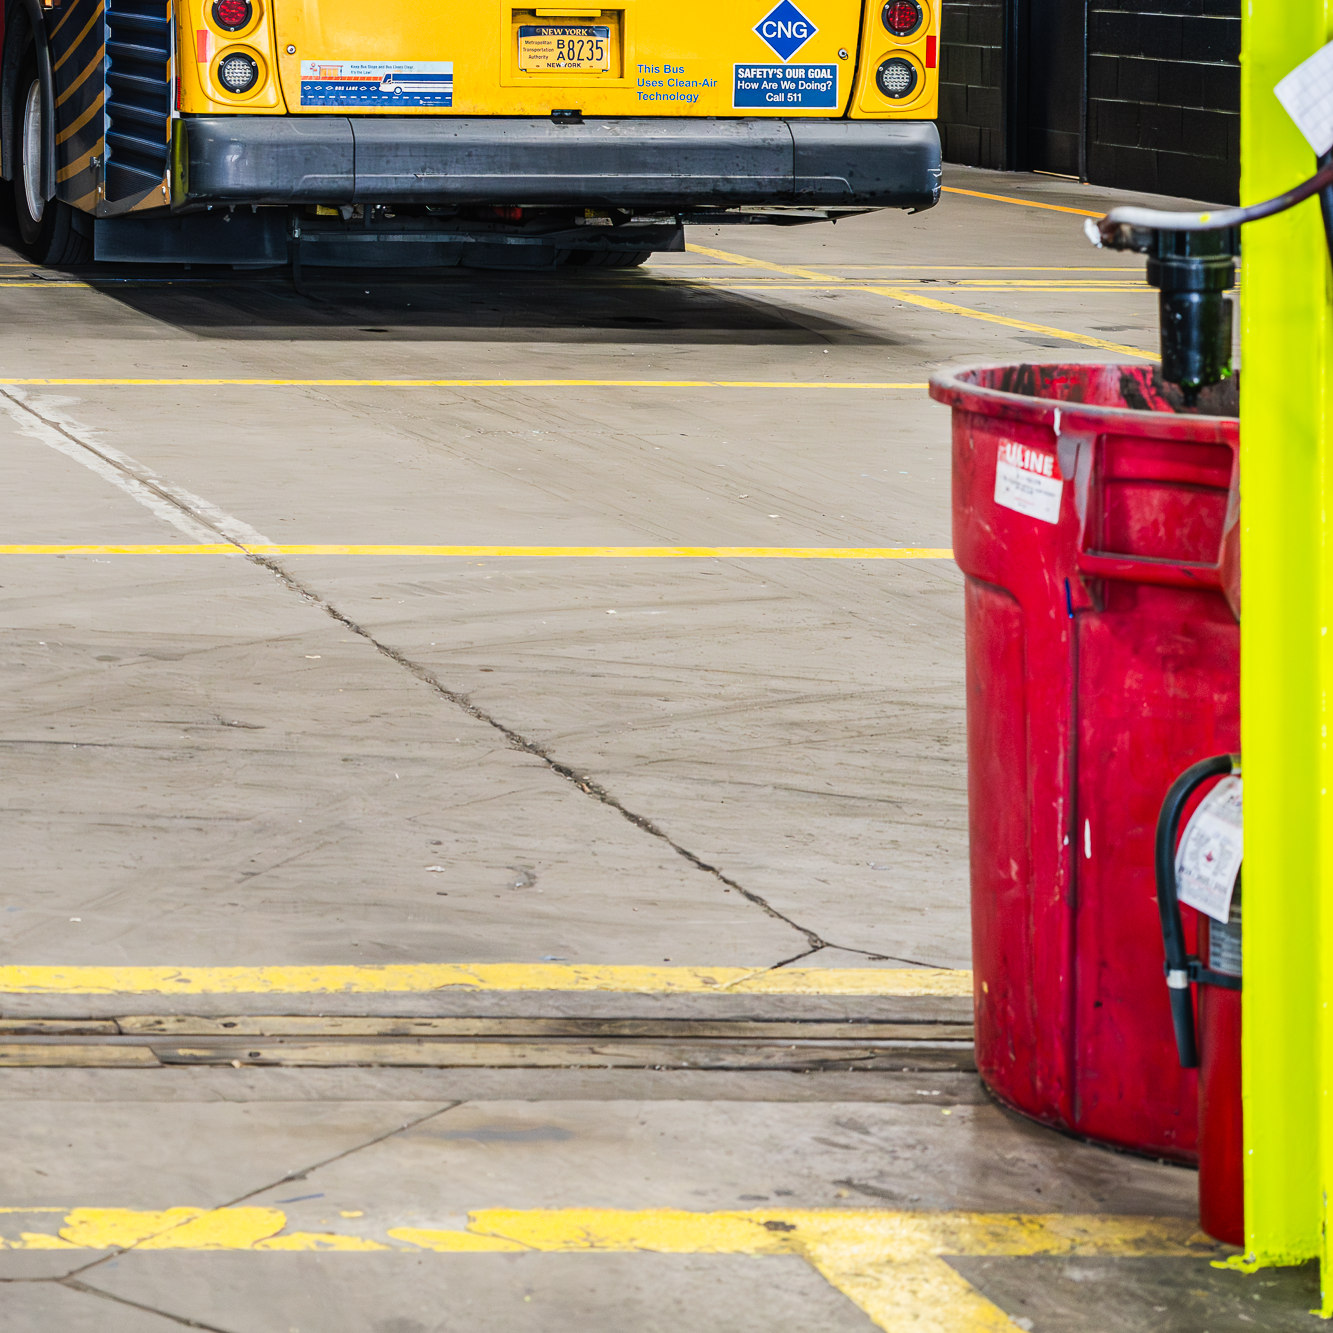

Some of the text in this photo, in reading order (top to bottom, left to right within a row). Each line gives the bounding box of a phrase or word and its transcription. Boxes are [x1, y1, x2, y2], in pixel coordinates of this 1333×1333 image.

[541, 28, 588, 36] NEW YORK
[762, 20, 808, 39] CNG
[567, 39, 604, 61] 8235
[637, 64, 685, 74] This Bus
[738, 68, 833, 79] SAFETY'S OUR GOAL
[637, 78, 718, 87] Uses Clean-Air
[737, 80, 832, 92] How Are We Doing?
[636, 91, 699, 103] Technology
[765, 92, 802, 102] Call 511
[1005, 441, 1054, 477] ULINE
